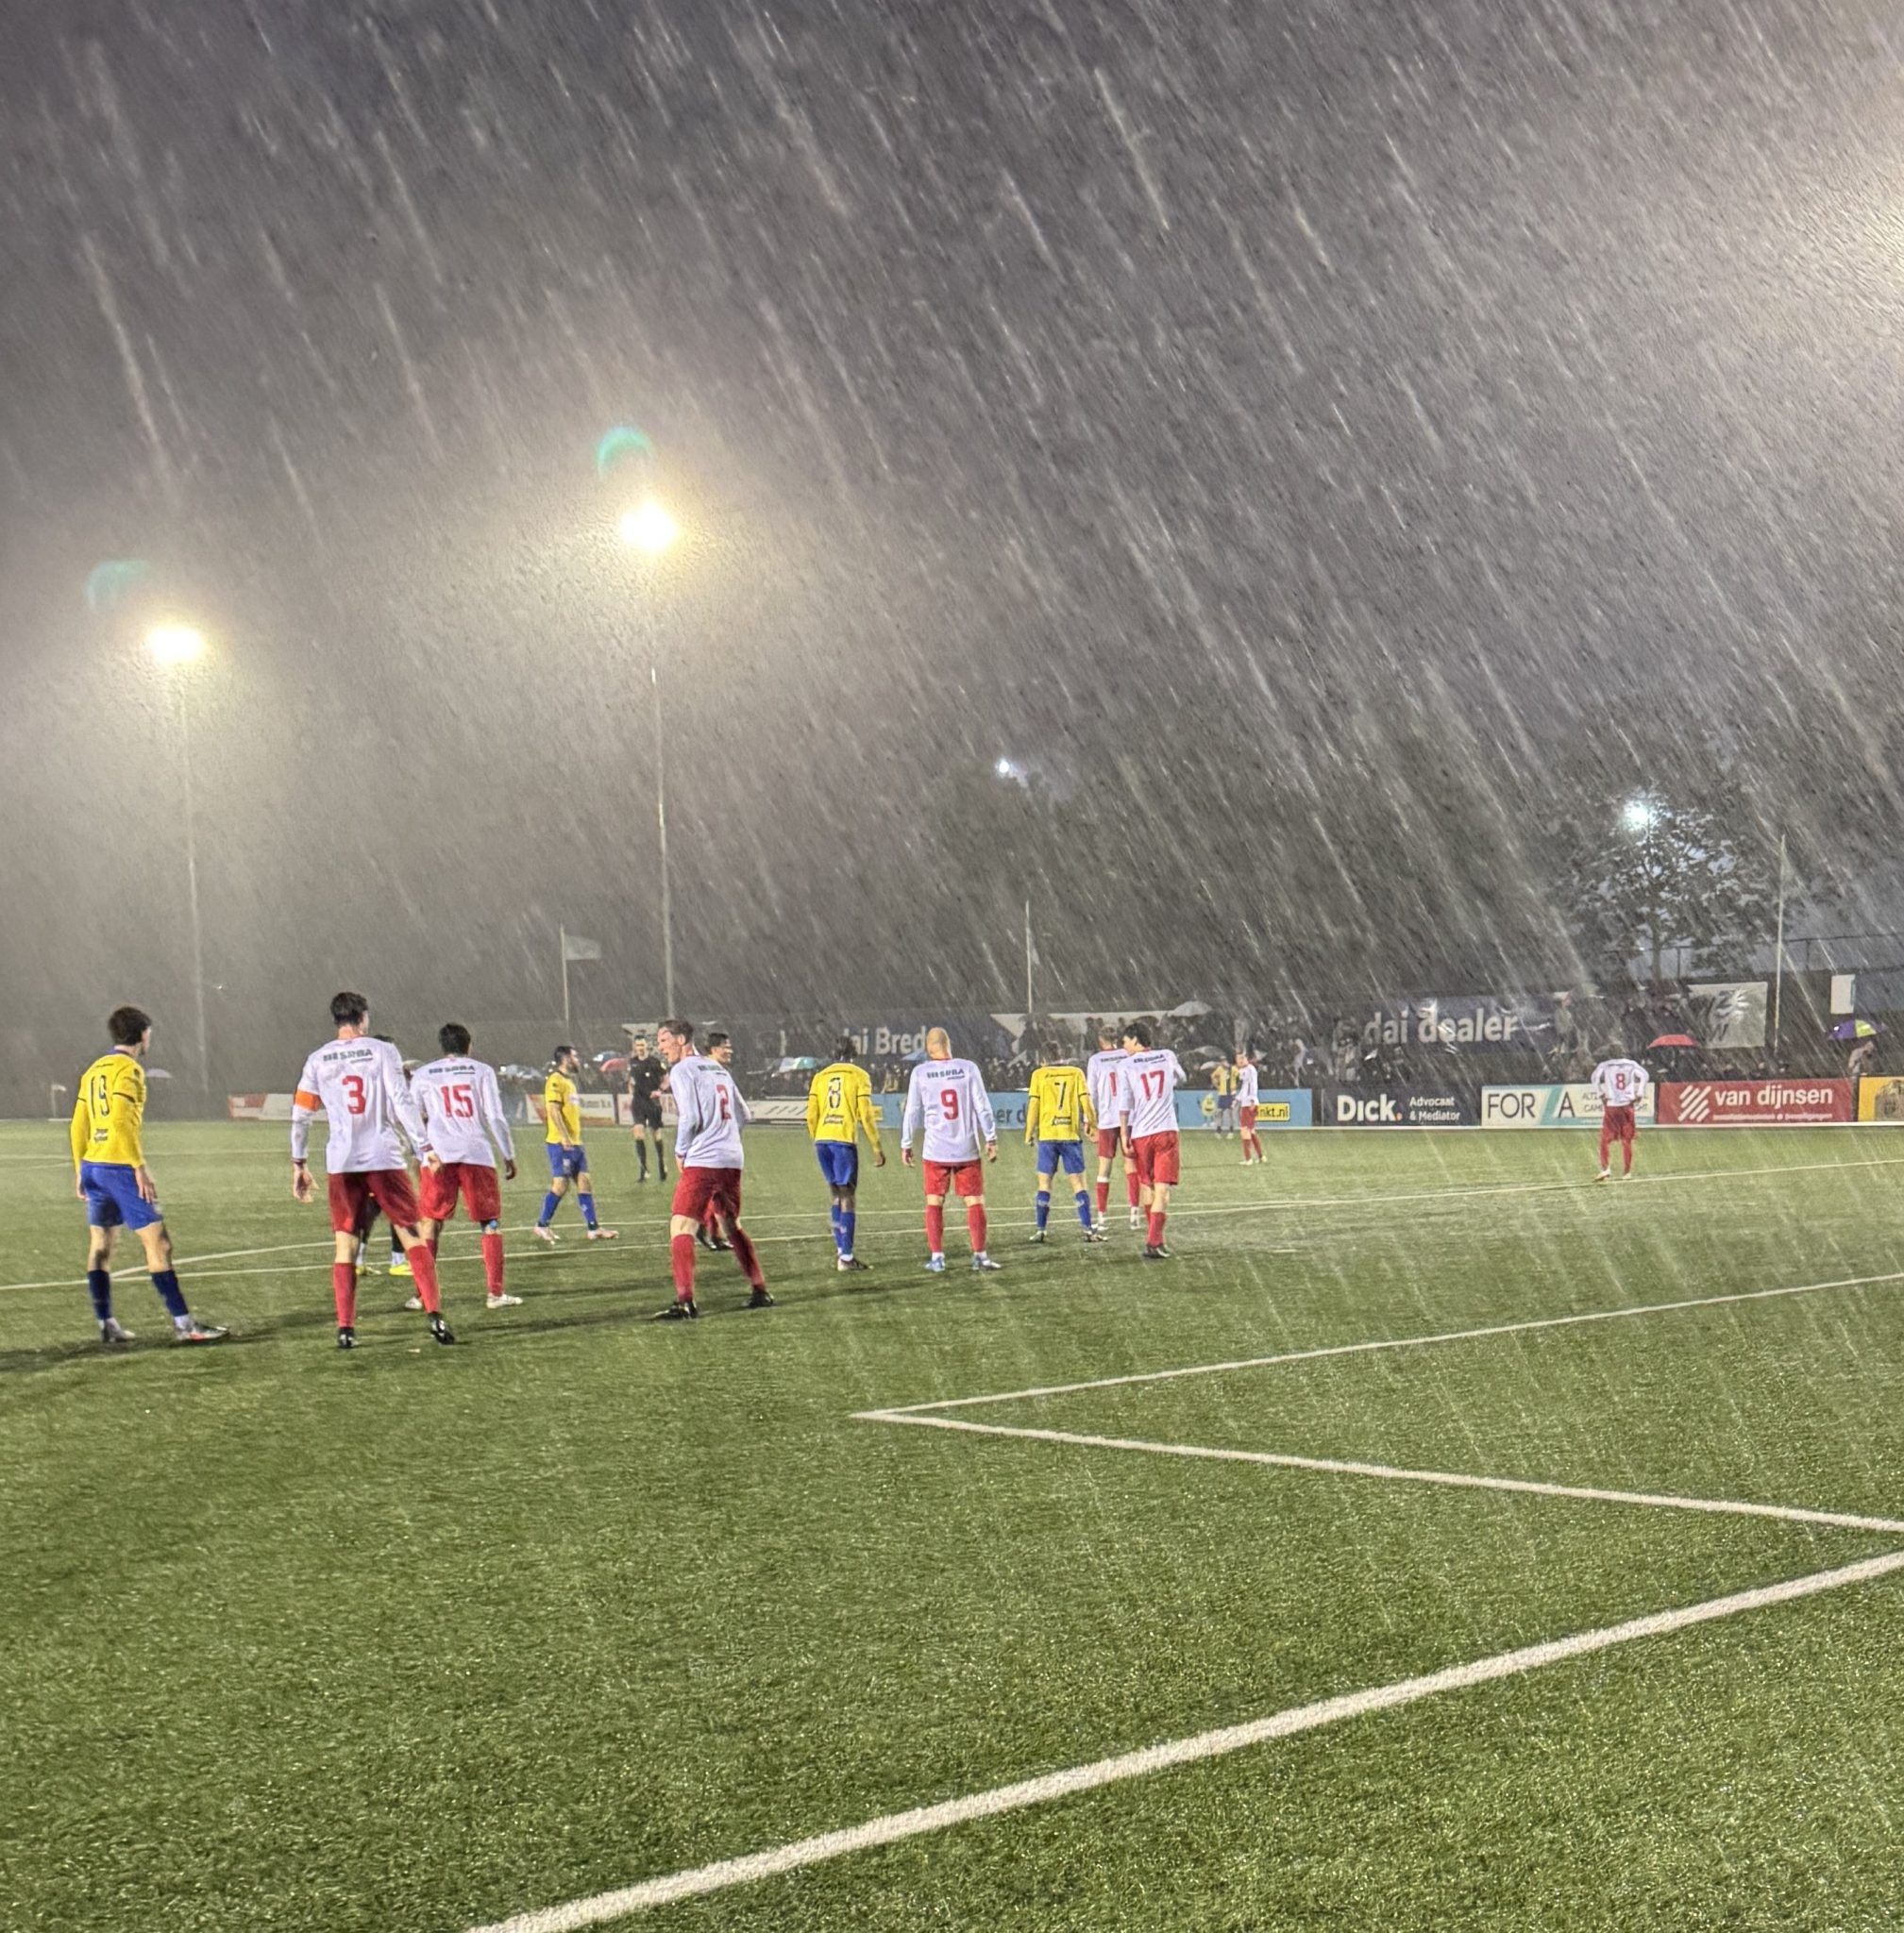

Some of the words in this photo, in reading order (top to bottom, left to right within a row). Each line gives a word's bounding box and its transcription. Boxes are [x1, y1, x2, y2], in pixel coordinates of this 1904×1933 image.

[1418, 1007, 1518, 1043] dealer
[91, 1074, 110, 1118] 19
[342, 1074, 366, 1115] 3
[1054, 1081, 1067, 1110] 7
[1140, 1070, 1165, 1102] 17
[1615, 1073, 1626, 1090] 8
[1714, 1089, 1751, 1106] van
[1757, 1084, 1833, 1110] dijnsen
[441, 1084, 473, 1118] 15
[716, 1084, 732, 1120] 2
[940, 1088, 959, 1120] 9
[1409, 1096, 1455, 1107] Advocaat
[1418, 1110, 1460, 1122] Mediator
